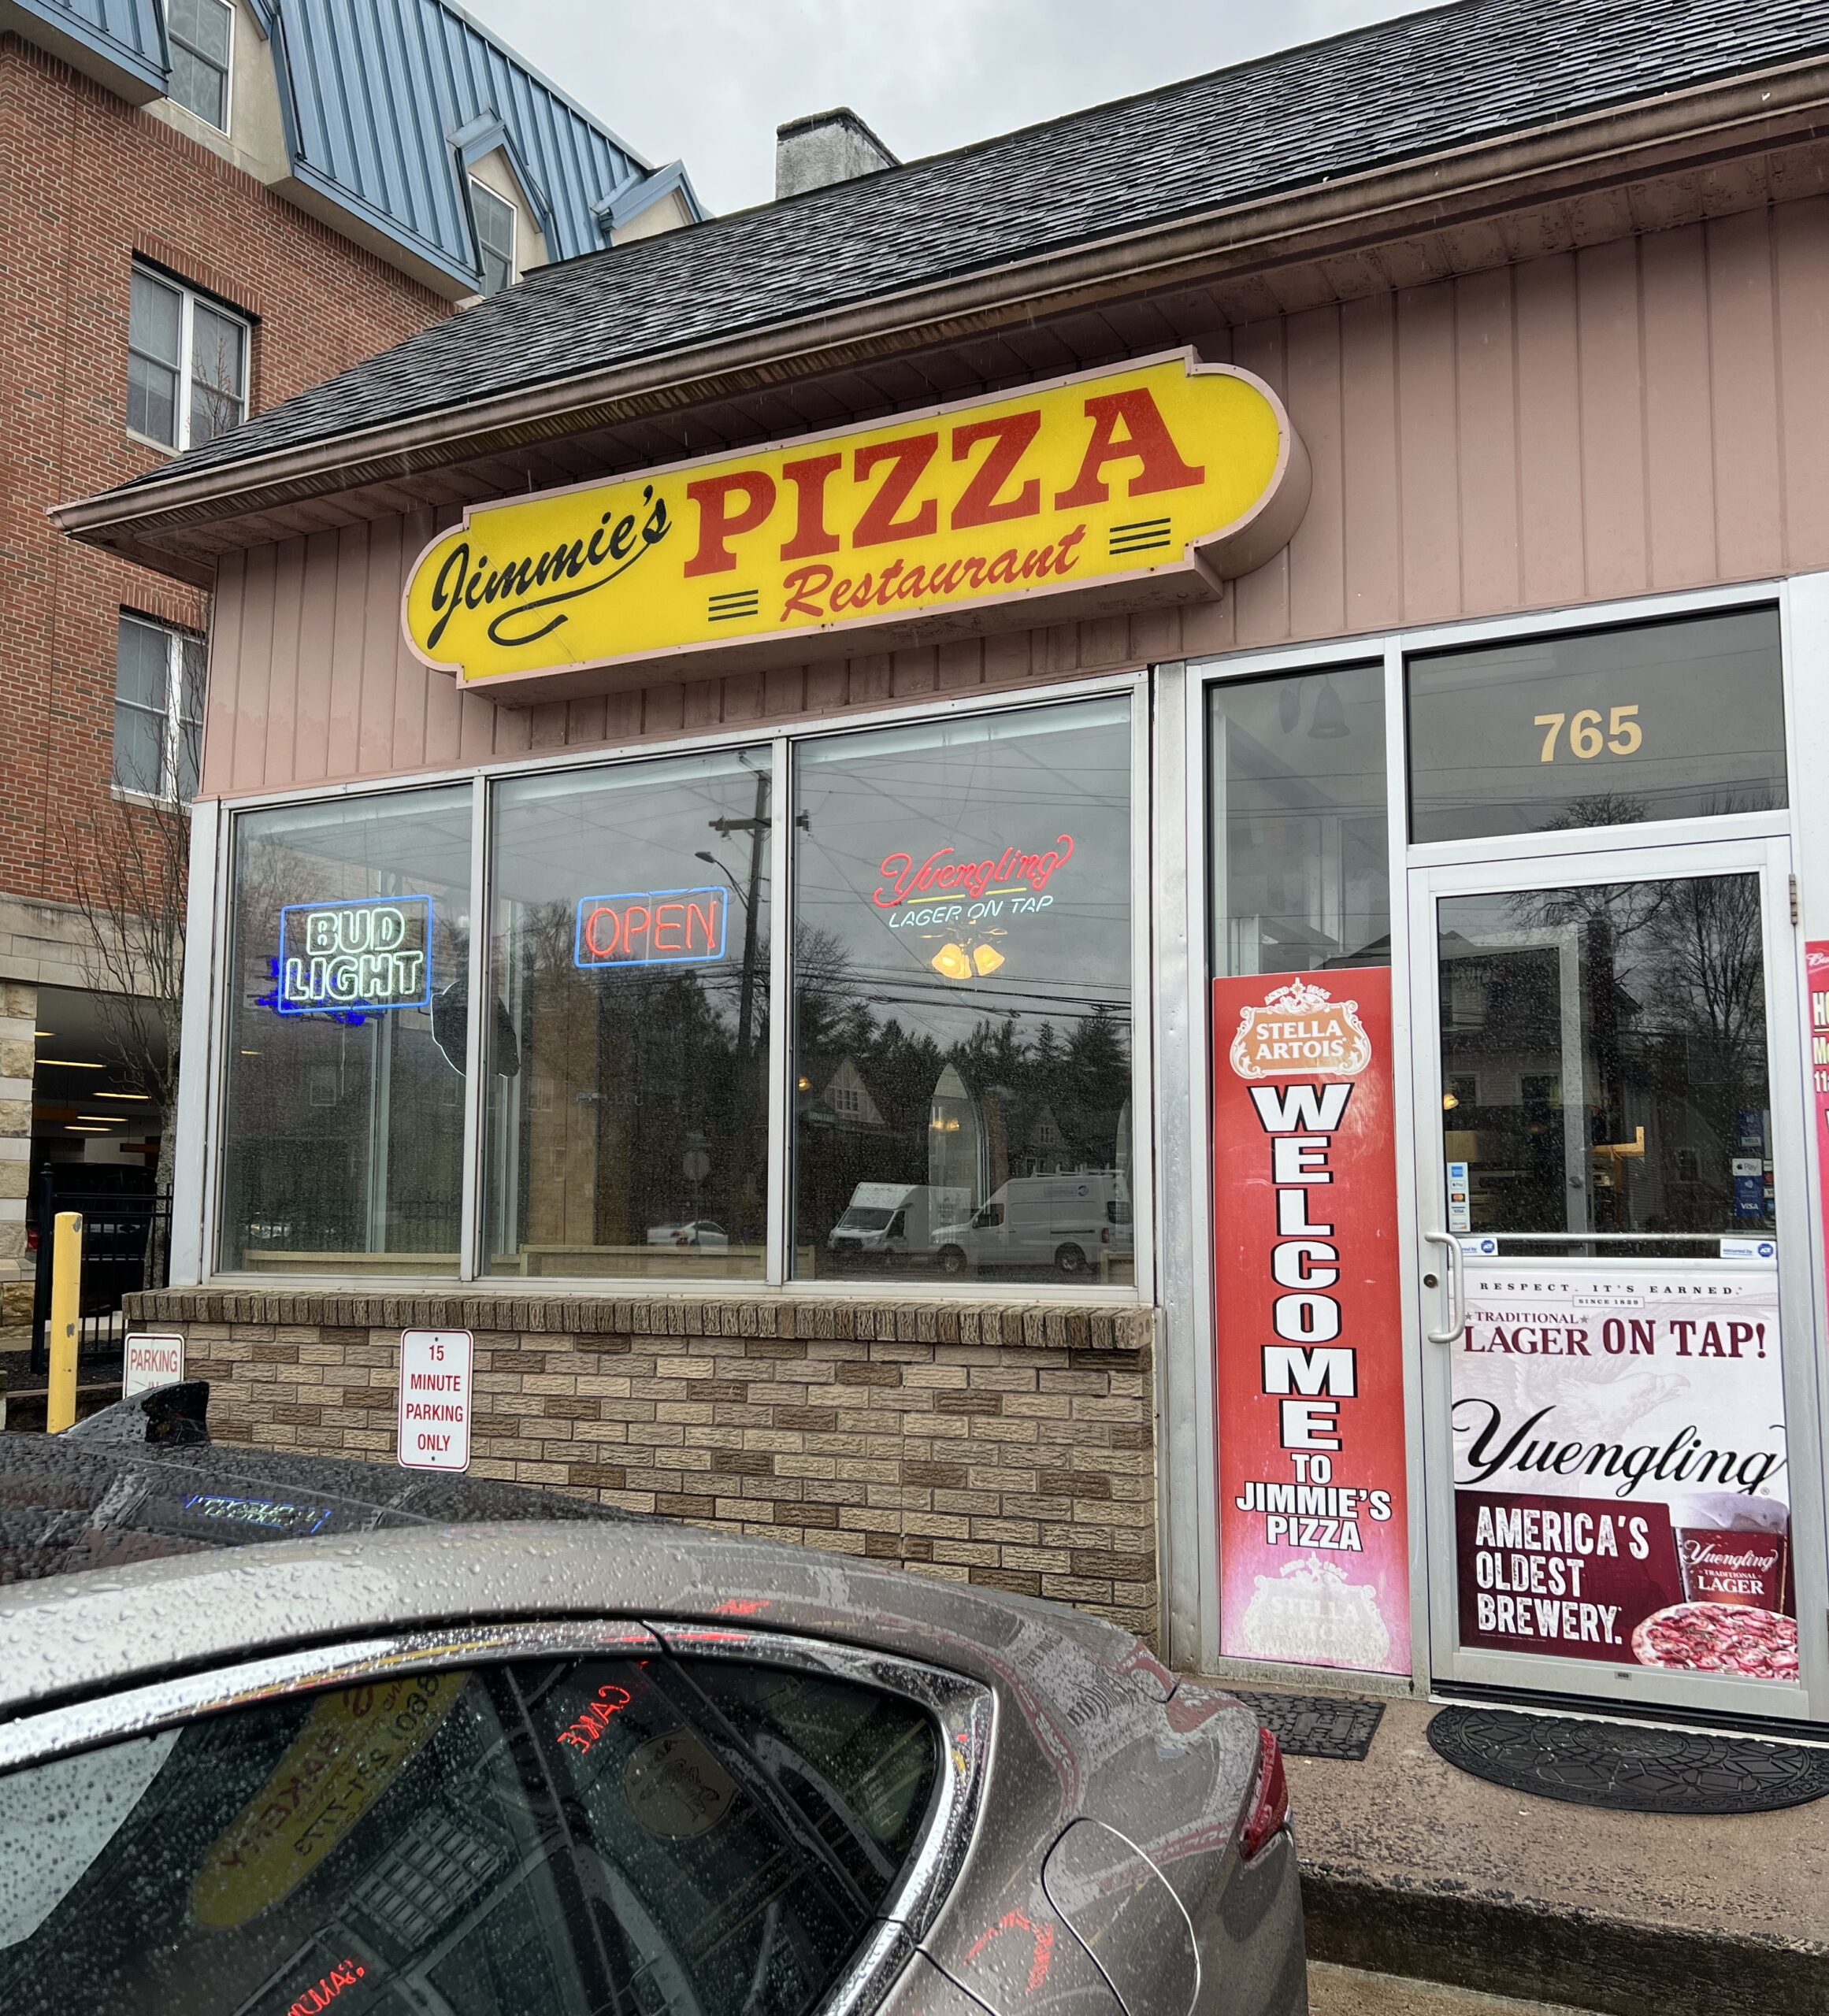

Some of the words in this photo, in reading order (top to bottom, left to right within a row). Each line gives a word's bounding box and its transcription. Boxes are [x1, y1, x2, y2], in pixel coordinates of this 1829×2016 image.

[426, 483, 673, 647] Jimmie's
[683, 387, 1205, 579] PIZZA
[780, 523, 1087, 624] Restaurant
[1534, 704, 1643, 763] 765
[873, 833, 1074, 908] Yuengling
[585, 900, 717, 957] OPEN
[889, 906, 963, 928] LAGER
[967, 899, 1004, 920] ON
[1011, 895, 1054, 914] TAP
[306, 906, 406, 956] BUD
[284, 950, 424, 1001] LIGHT
[1256, 1019, 1344, 1041] STELLA
[1255, 1039, 1345, 1060] ARTOIS
[1247, 1082, 1359, 1451] WELCOME
[1480, 1282, 1579, 1292] RESPECT.
[1593, 1284, 1634, 1294] IT'S
[1649, 1285, 1739, 1296] EARNED.
[1475, 1311, 1579, 1324] TRADITIONAL
[428, 1344, 445, 1362] 15
[1464, 1325, 1592, 1356] LAGER
[1602, 1317, 1656, 1355] ON
[1670, 1320, 1767, 1358] TAP!
[130, 1348, 178, 1373] PARKING
[410, 1373, 462, 1392] MINUTE
[406, 1403, 464, 1423] PARKING
[417, 1433, 451, 1452] ONLY
[1452, 1398, 1786, 1498] Yuengling
[1290, 1453, 1333, 1484] TO
[1235, 1480, 1393, 1521] JIMMIE'S
[1266, 1514, 1363, 1552] PIZZA
[1475, 1506, 1649, 1559] AMERICA'S
[1682, 1539, 1779, 1572] Yuengling
[1475, 1551, 1585, 1598] OLDEST
[1697, 1575, 1765, 1595] LAGER
[1703, 1569, 1758, 1580] TRADITIONAL
